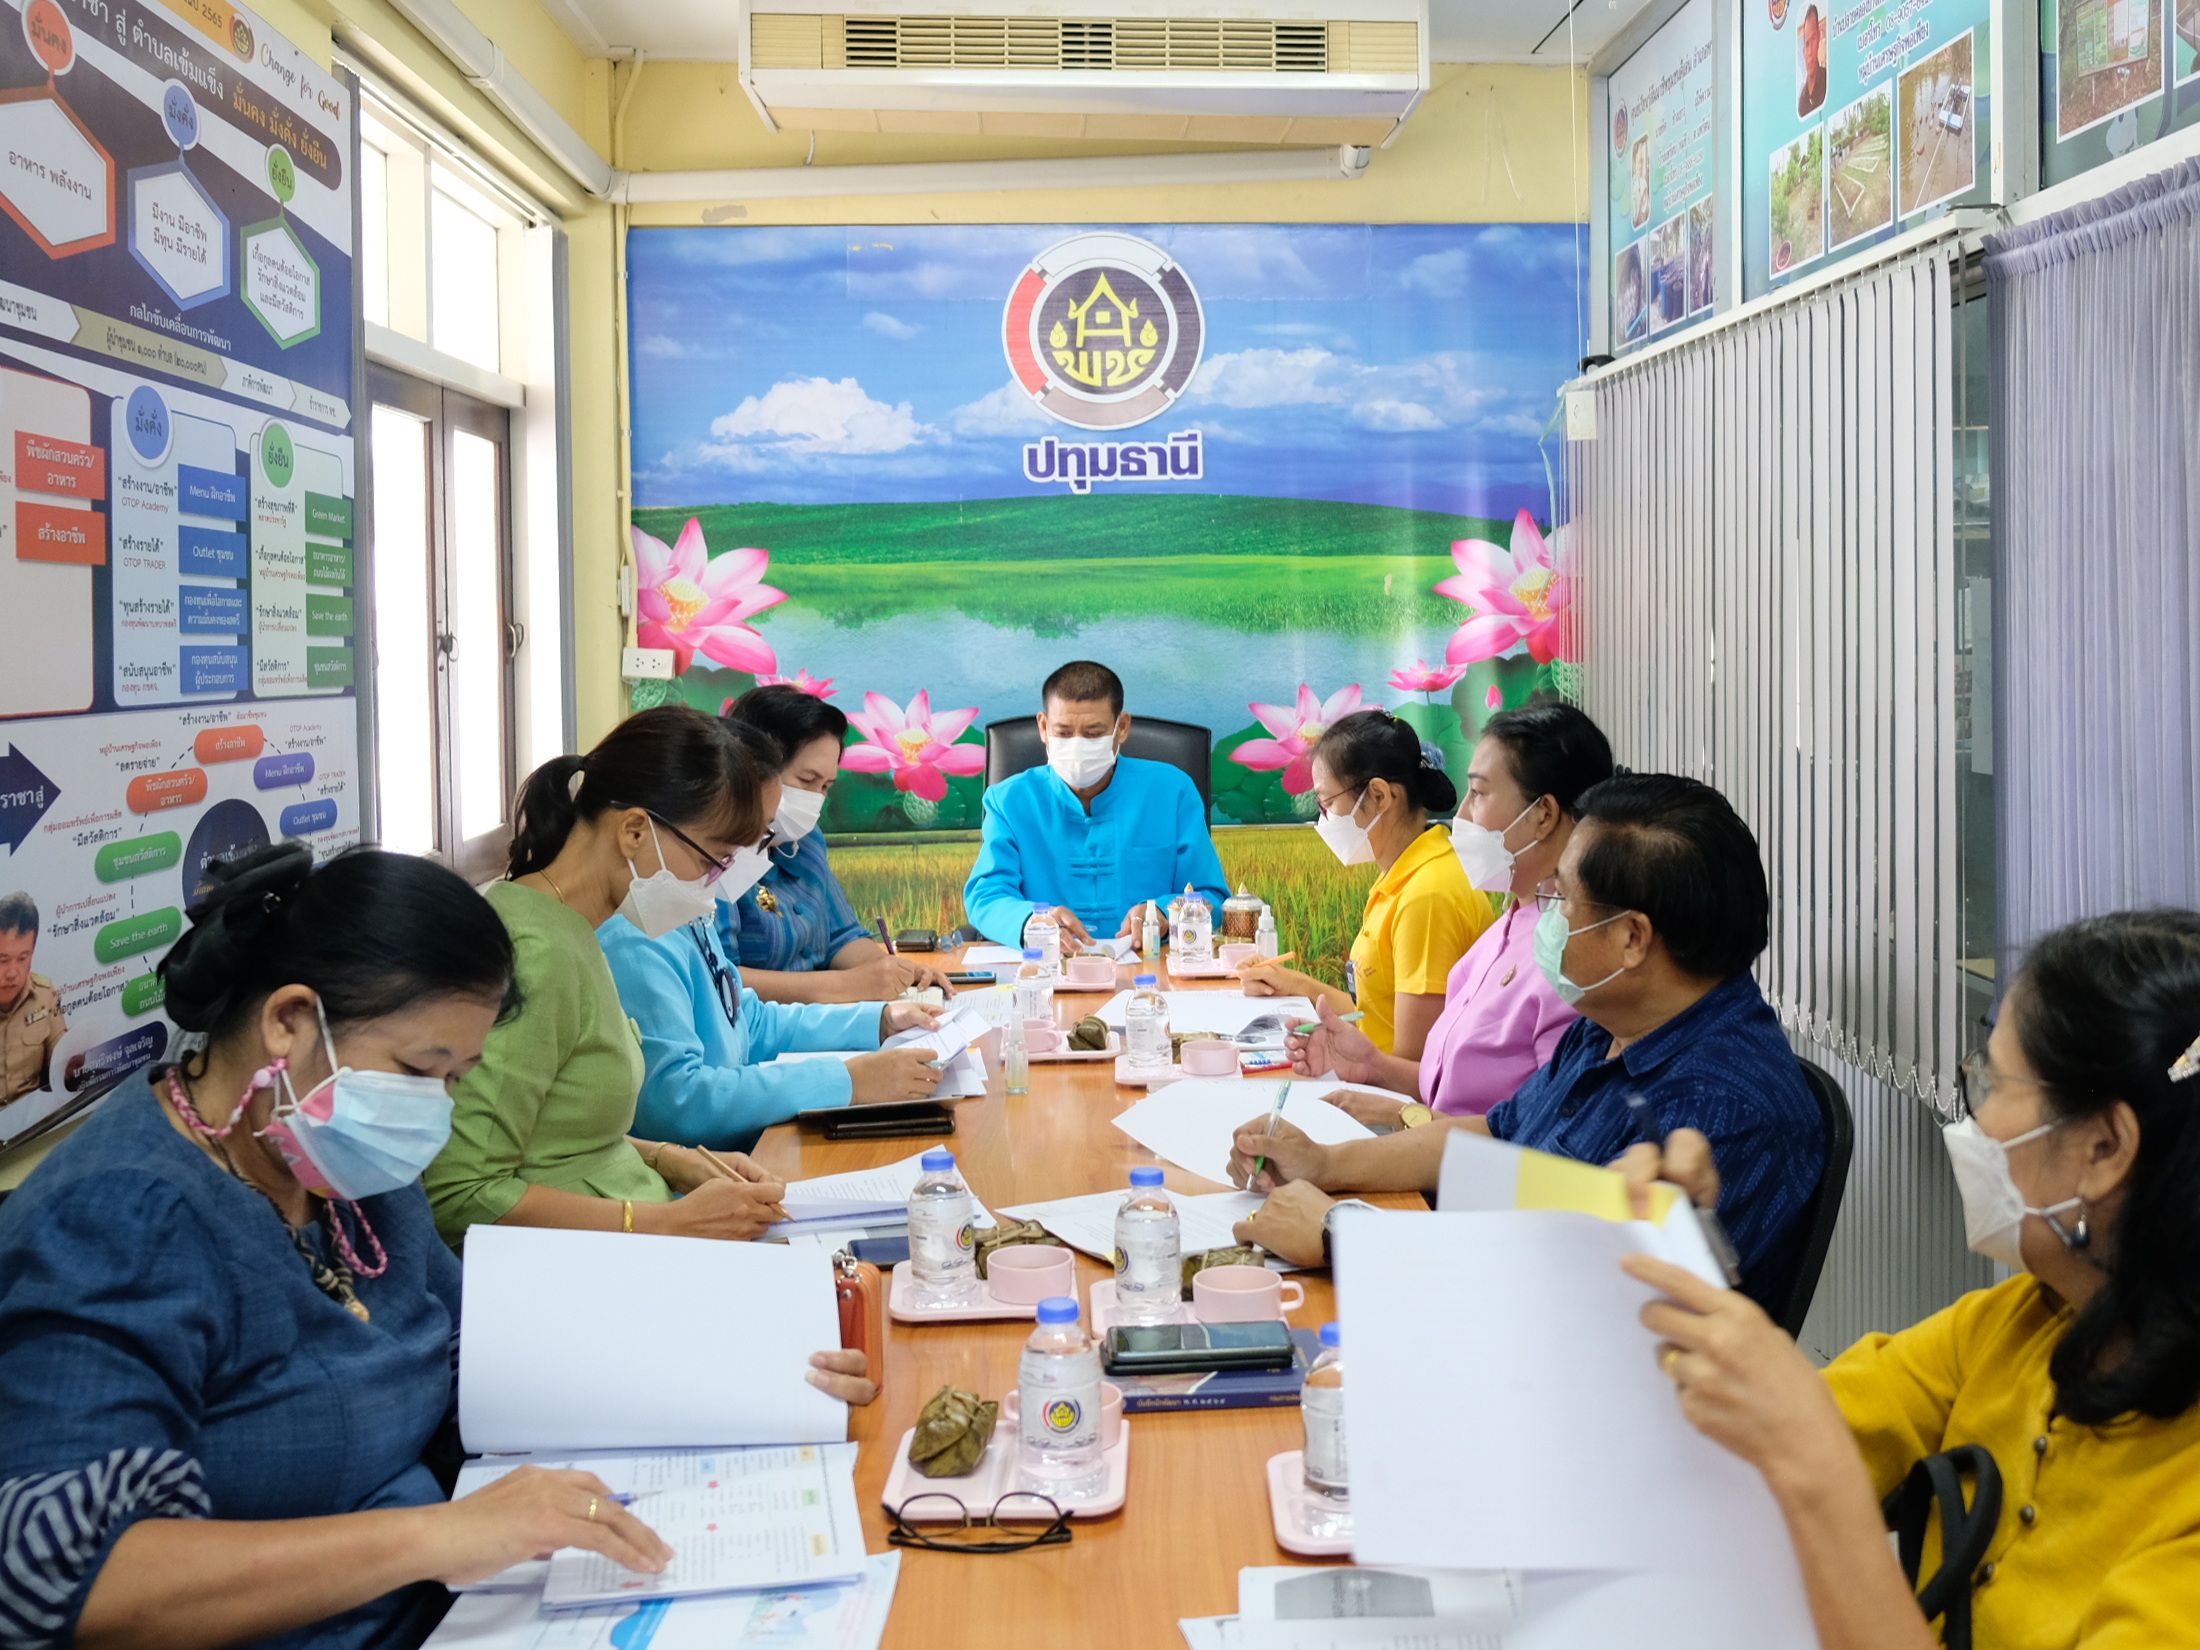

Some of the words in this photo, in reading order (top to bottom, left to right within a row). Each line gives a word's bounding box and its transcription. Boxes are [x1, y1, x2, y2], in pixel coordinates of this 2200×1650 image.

[31, 12, 67, 54] มั่นคง
[133, 19, 224, 100] ตำบลเข้มแข็ง
[233, 83, 266, 127] มั่นคง
[269, 107, 298, 149] มั่งคั่ง
[301, 127, 327, 170] ยั่งยืน
[261, 42, 296, 87] Change
[300, 75, 314, 99] for
[318, 90, 341, 121] Good
[168, 96, 194, 130] มั่งคั่ง
[9, 150, 46, 179] อาหาร
[50, 169, 92, 200] พลังงาน
[271, 159, 293, 191] ยั่งยืน
[152, 202, 176, 227] มีงาน
[178, 214, 208, 243] มีอาชีพ
[153, 226, 174, 253] มีทุน
[176, 237, 207, 265] มีรายได้
[130, 302, 232, 352] กลไกขับเคลื่อนการพัฒนา
[135, 406, 162, 437] มั่งคั่ง
[26, 439, 95, 468] พืชผักสวนครัว/
[268, 441, 290, 469] ยั่งยืน
[1027, 433, 1199, 490] ปทุมธานี
[47, 472, 77, 488] อาหาร
[189, 485, 210, 499] Menu
[121, 496, 141, 508] OTOP
[141, 500, 169, 514] Academy
[38, 522, 86, 544] สร้างอาชีพ
[123, 557, 142, 569] OTOP
[143, 559, 166, 570] TRADER
[193, 545, 215, 560] Outlet
[216, 549, 234, 564] ชุมชน
[311, 609, 325, 620] Save
[325, 611, 334, 621] the
[289, 724, 302, 733] OTOP
[265, 767, 283, 778] Menu
[160, 793, 182, 807] อาหาร
[110, 934, 130, 949] Save
[132, 929, 146, 940] the
[147, 923, 168, 937] earth
